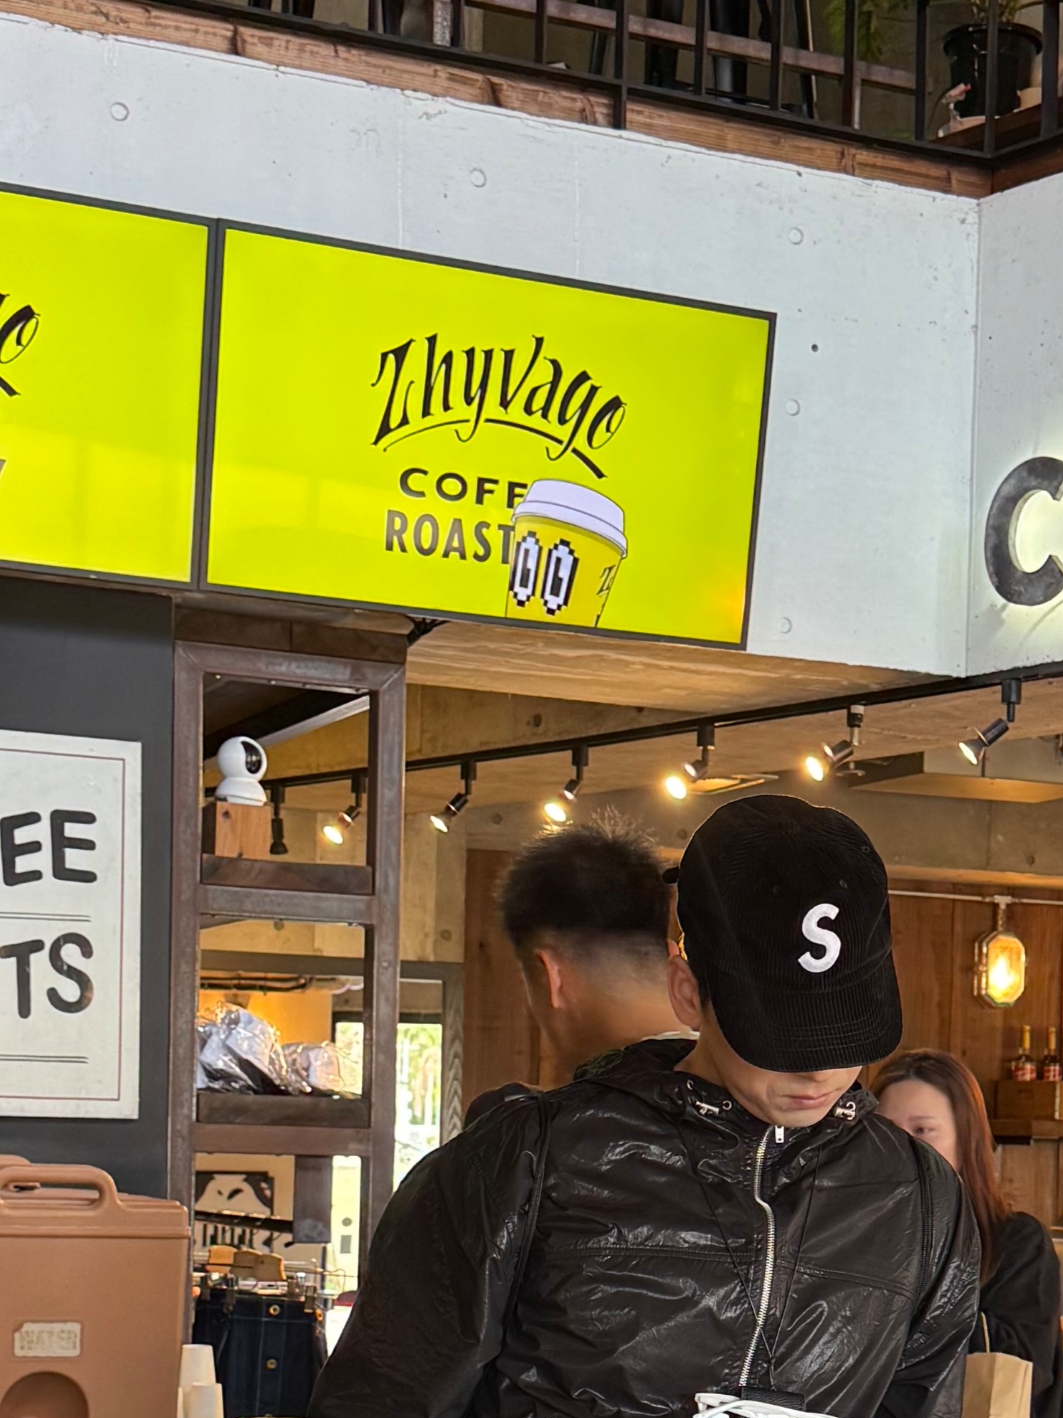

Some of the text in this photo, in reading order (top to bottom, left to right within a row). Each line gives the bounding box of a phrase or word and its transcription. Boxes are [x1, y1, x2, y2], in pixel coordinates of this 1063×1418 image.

[370, 333, 628, 468] Zhyvago
[400, 467, 528, 509] COFF
[385, 509, 515, 566] ROAST
[797, 903, 842, 973] S
